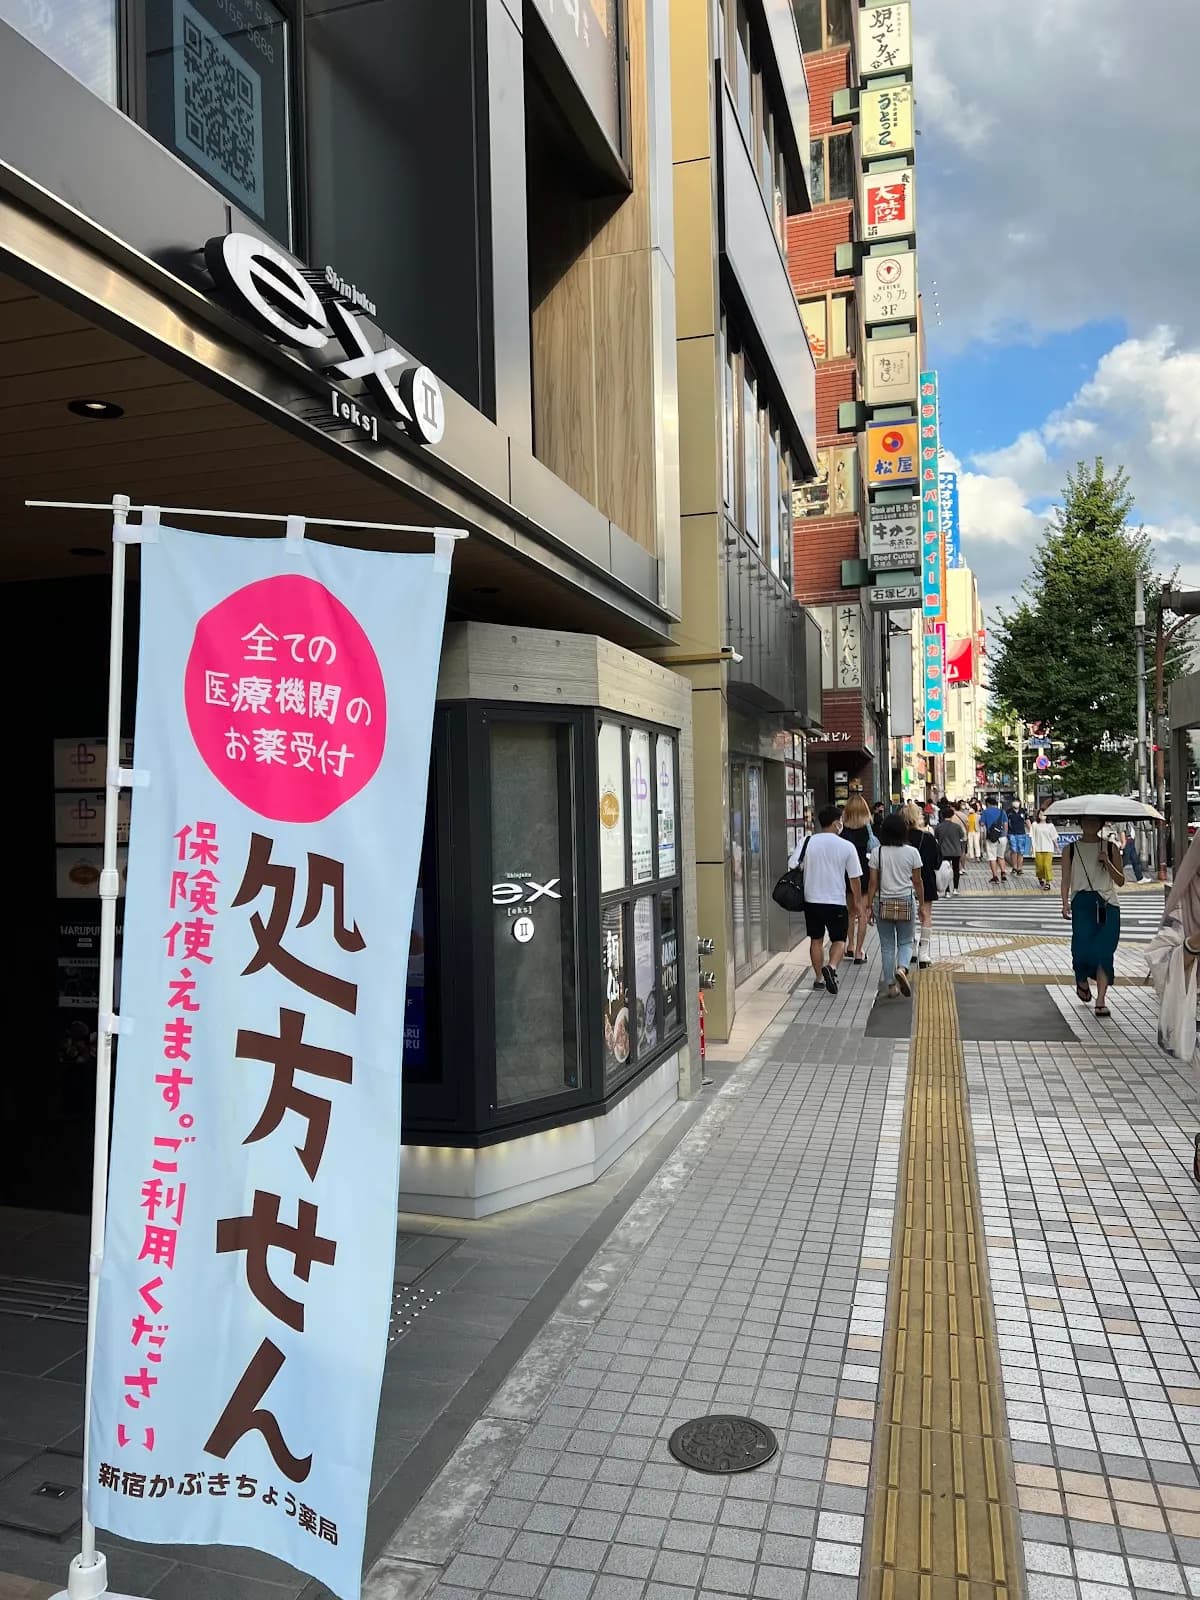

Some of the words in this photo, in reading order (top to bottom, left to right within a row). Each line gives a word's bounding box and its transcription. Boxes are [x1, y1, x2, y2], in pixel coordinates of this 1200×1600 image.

[325, 265, 376, 316] Shinjuku
[881, 304, 898, 316] 3F
[874, 456, 913, 476] 松屋
[872, 522, 917, 540] 牛かつ
[873, 554, 891, 562] Beef
[893, 552, 916, 560] Cutlet
[873, 587, 918, 600] 石塚ビル
[240, 622, 337, 665] 全ての
[204, 669, 372, 726] 医療機関の
[223, 726, 355, 778] お薬受付
[203, 831, 367, 1484] 処方せん
[97, 1462, 339, 1547] 新宿かぶきちょう薬局
